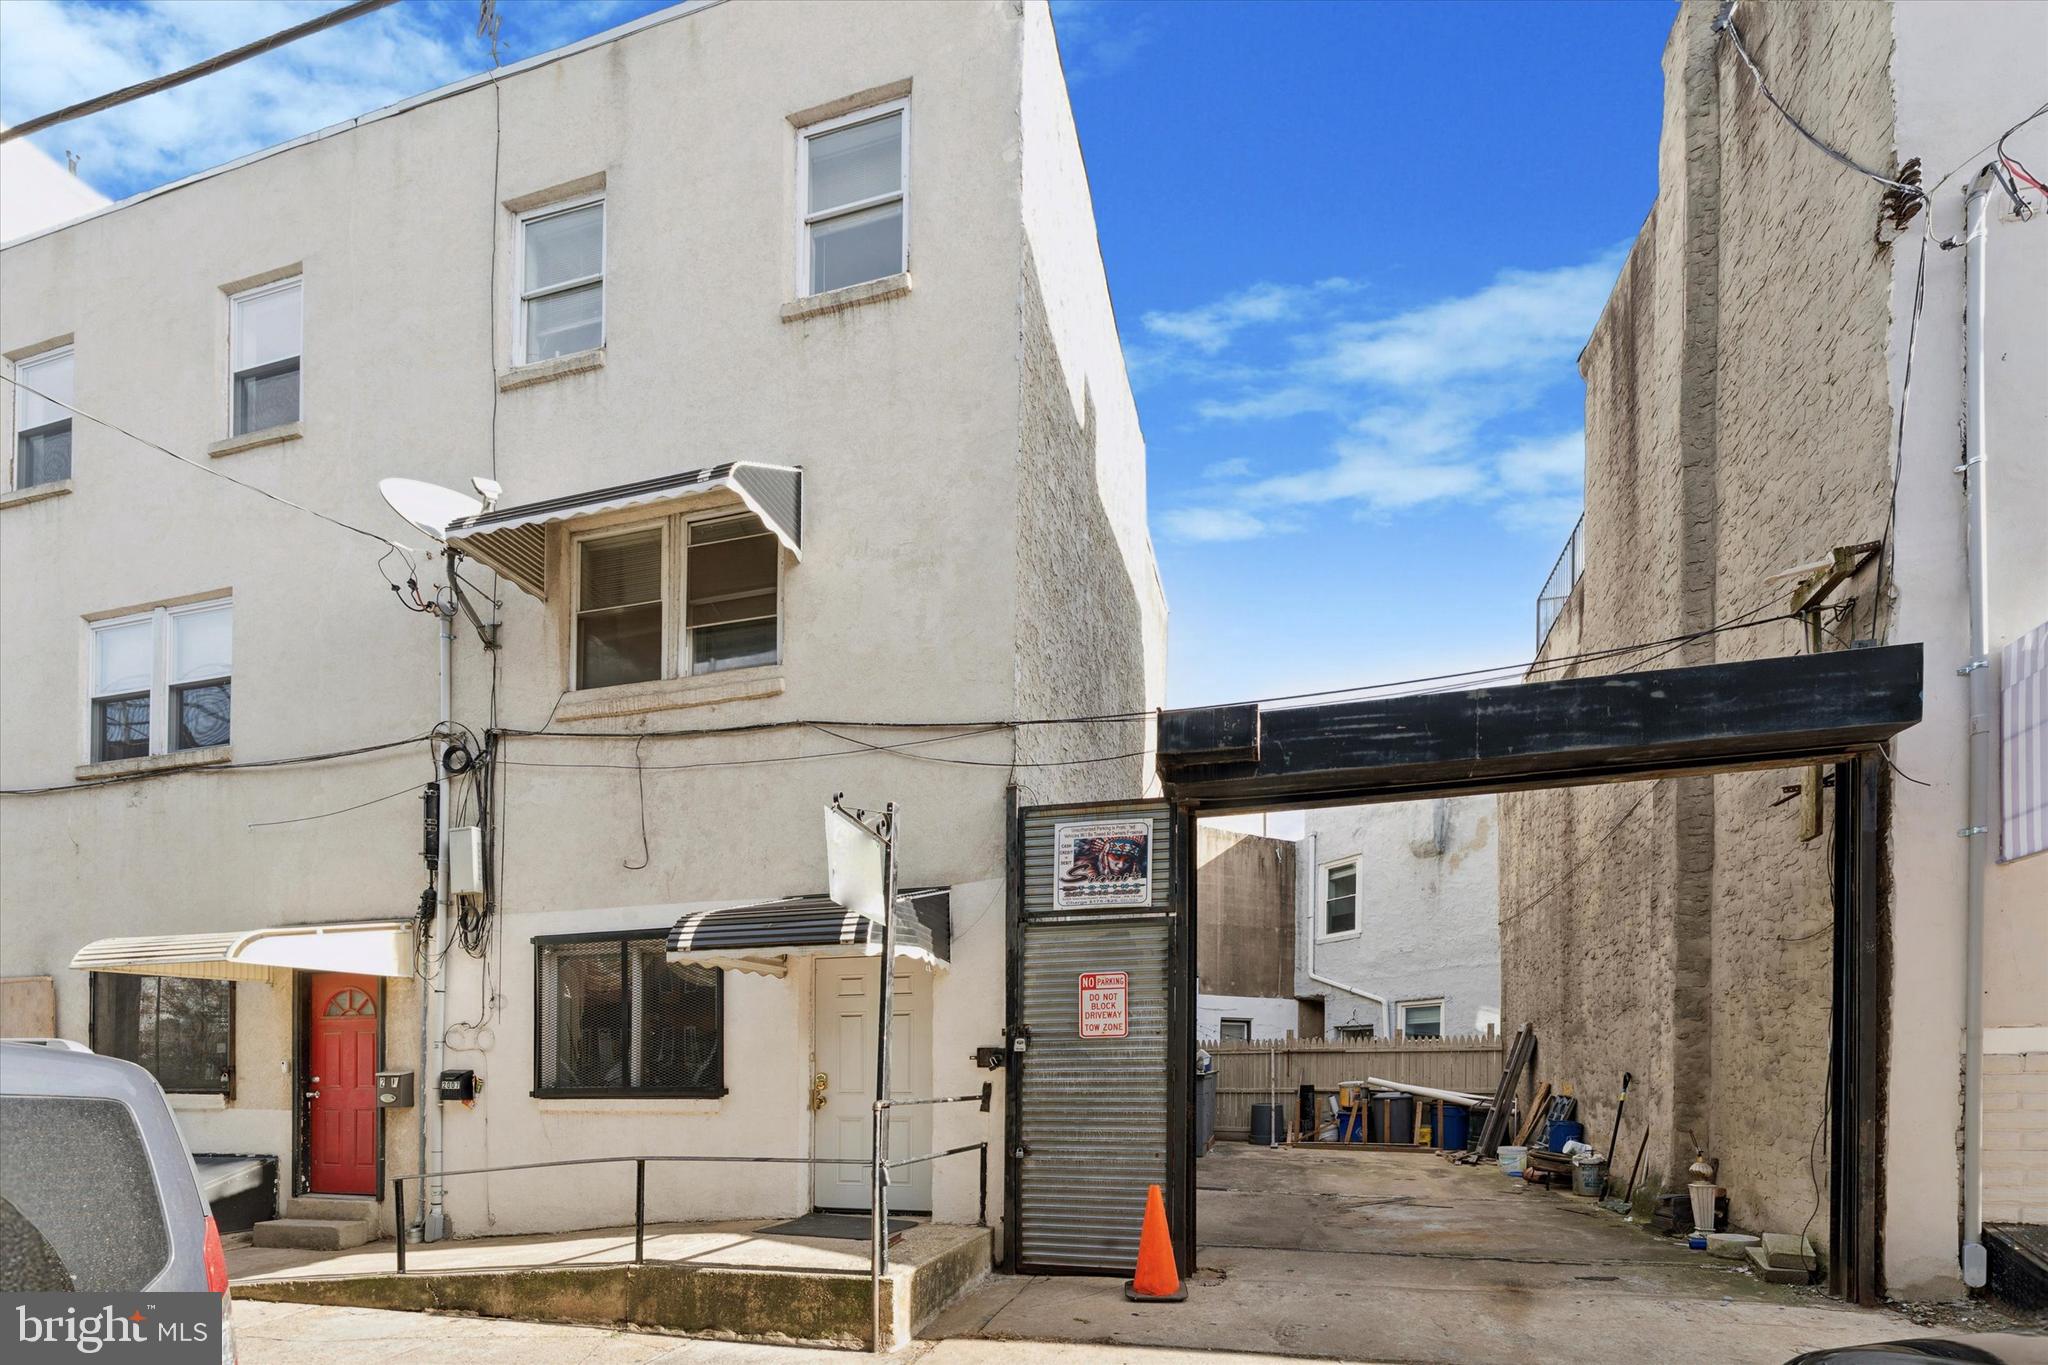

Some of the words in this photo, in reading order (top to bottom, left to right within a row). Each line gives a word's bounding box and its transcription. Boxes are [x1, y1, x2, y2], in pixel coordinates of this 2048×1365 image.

[1082, 977, 1095, 988] NO
[1097, 977, 1124, 986] PARKING
[1089, 993, 1100, 1002] DO
[1103, 993, 1118, 1001] NOT
[1091, 1001, 1116, 1010] BLOCK
[1085, 1011, 1122, 1020] DRIVEWAY
[1085, 1023, 1100, 1032] TOW
[1103, 1022, 1124, 1031] ZONE
